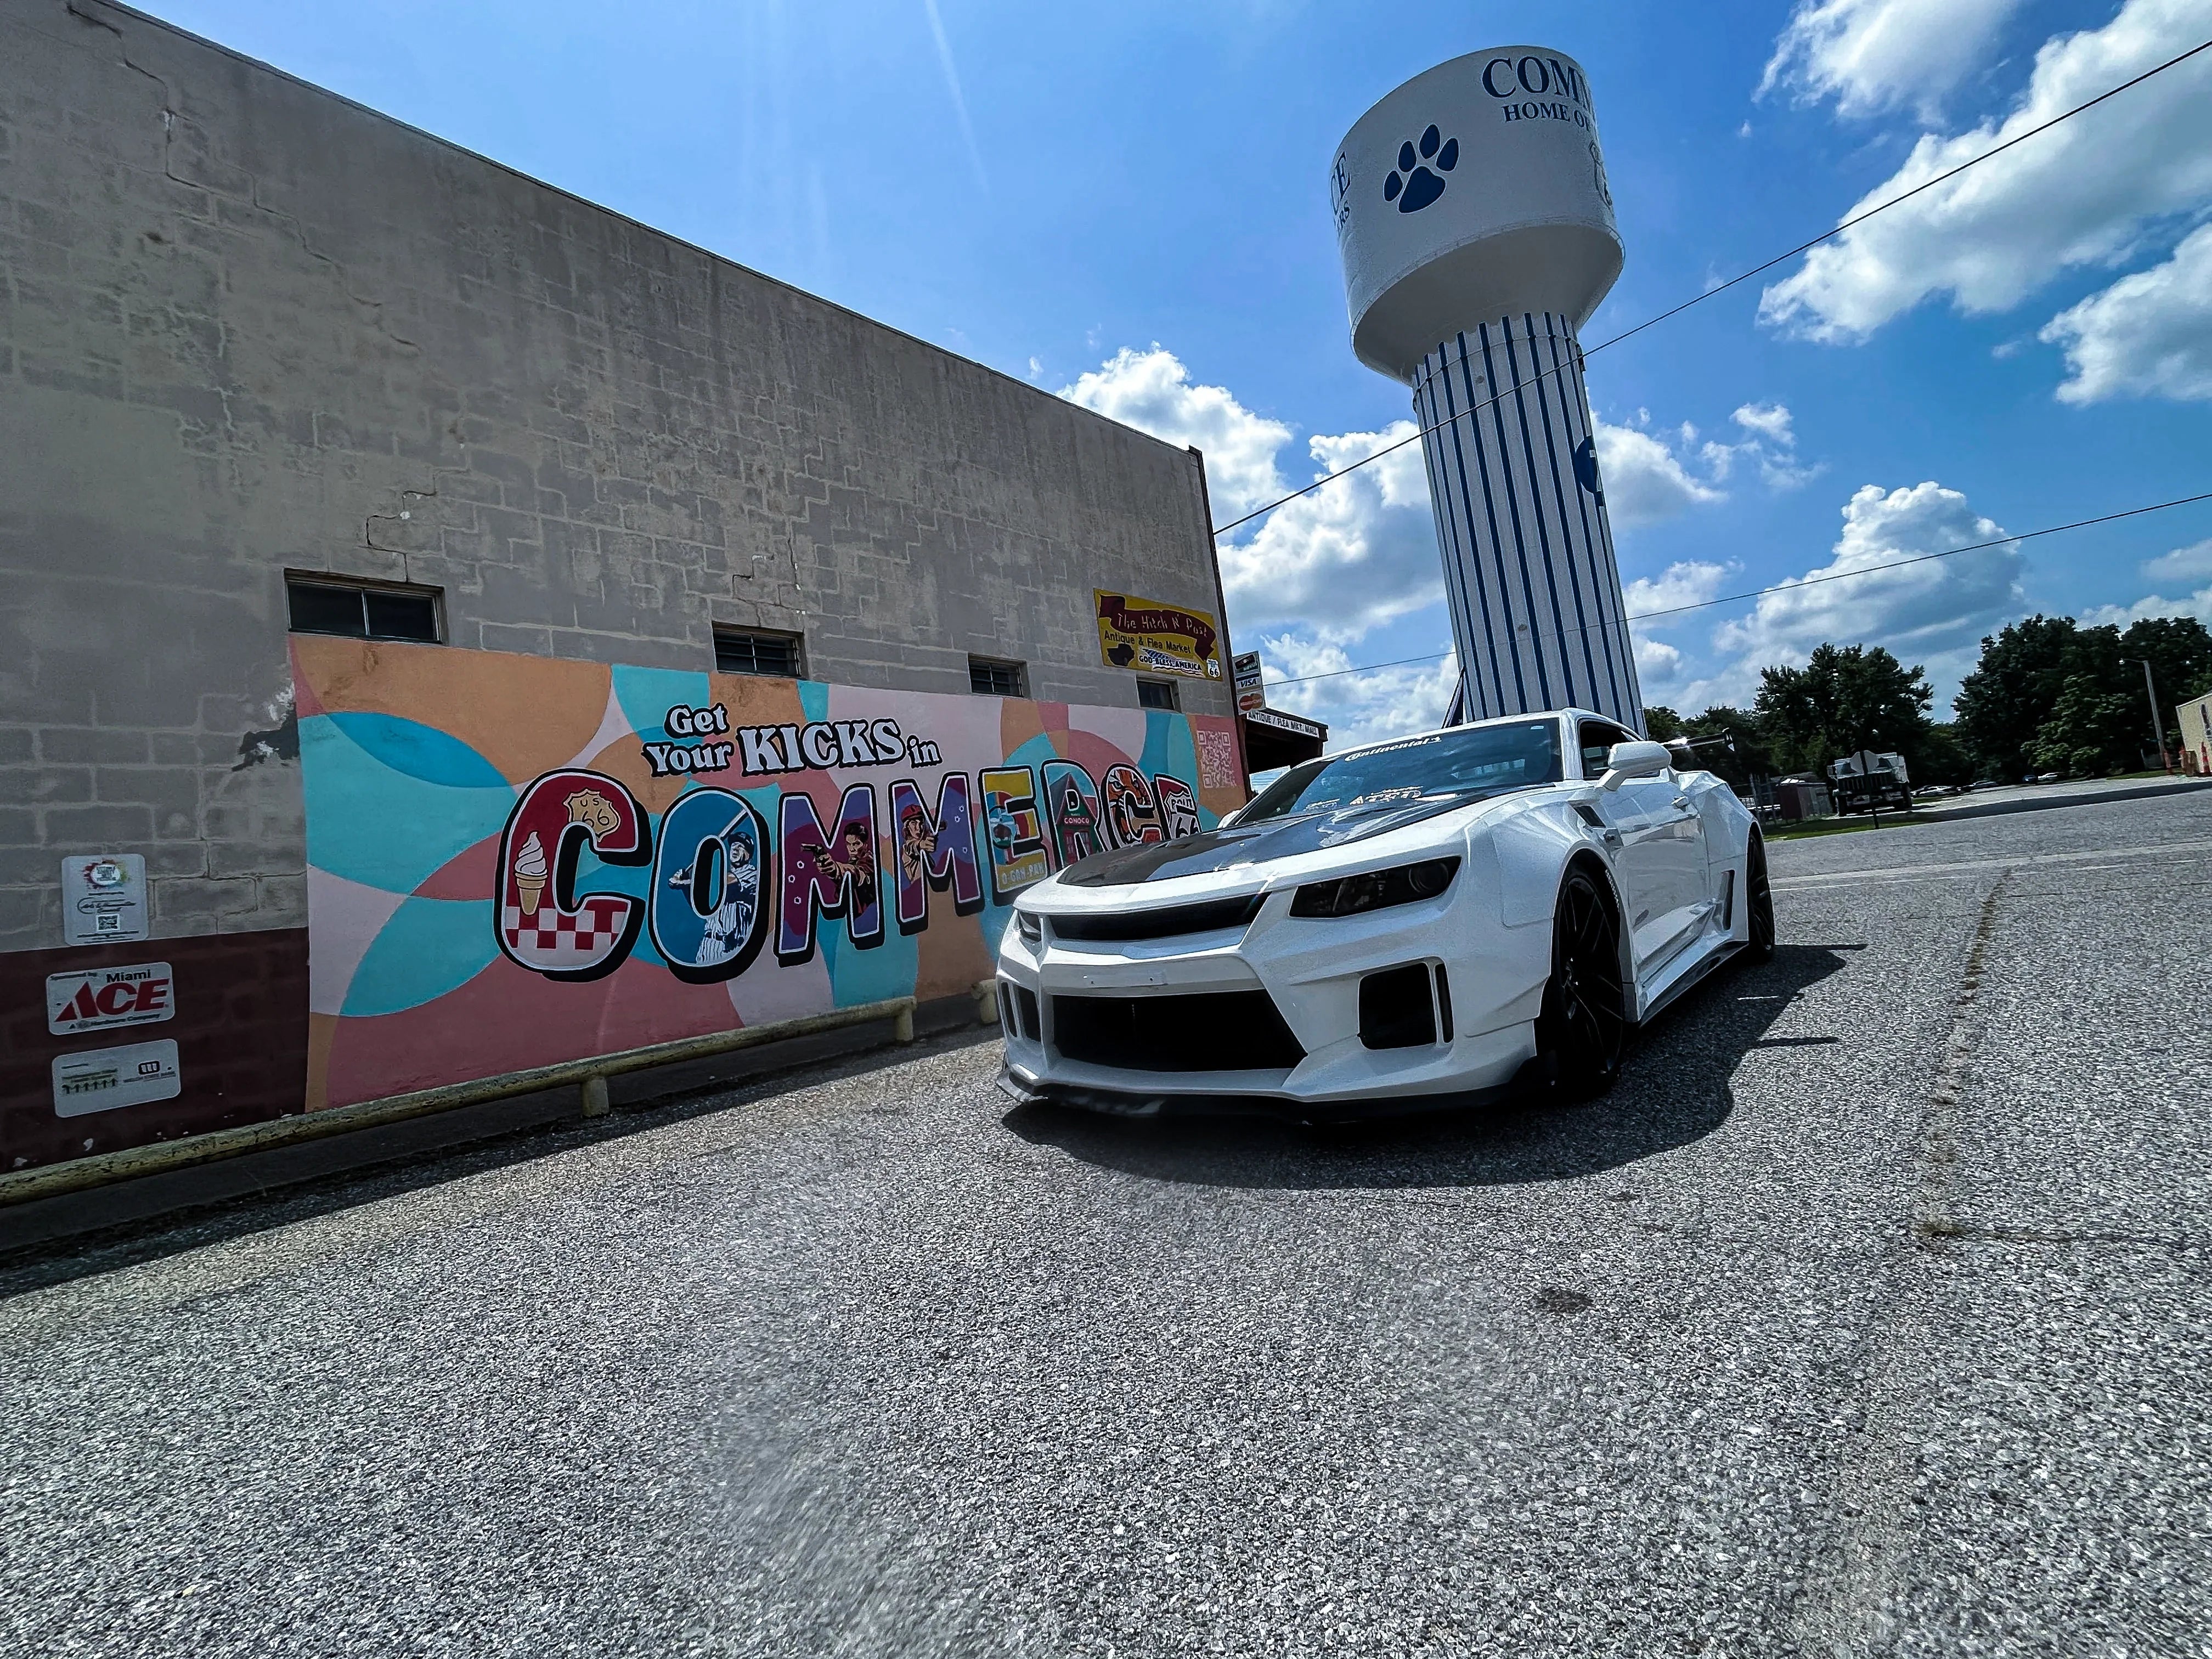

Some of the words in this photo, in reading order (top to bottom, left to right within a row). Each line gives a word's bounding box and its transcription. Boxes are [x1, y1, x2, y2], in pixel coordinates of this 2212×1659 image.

[1502, 102, 1570, 122] HOME
[1118, 613, 1136, 629] The
[1142, 615, 1168, 630] Hitch
[1104, 630, 1135, 645] Antique
[1138, 637, 1144, 645] &
[1147, 637, 1164, 648] Flea
[1166, 640, 1191, 654] Market
[1139, 655, 1153, 664] GOD
[1155, 657, 1172, 667] BLESS
[1175, 660, 1203, 671] AMERICA
[1209, 667, 1219, 676] 66
[1240, 678, 1257, 688] VISA
[665, 703, 730, 738] Get
[1277, 718, 1290, 729] FLEA
[642, 741, 734, 776] Your
[736, 718, 906, 776] KICKS
[908, 735, 943, 768] in
[1344, 738, 1430, 762] Continental
[582, 808, 610, 828] 66
[106, 968, 151, 983] Miami
[55, 978, 170, 1023] ACE
